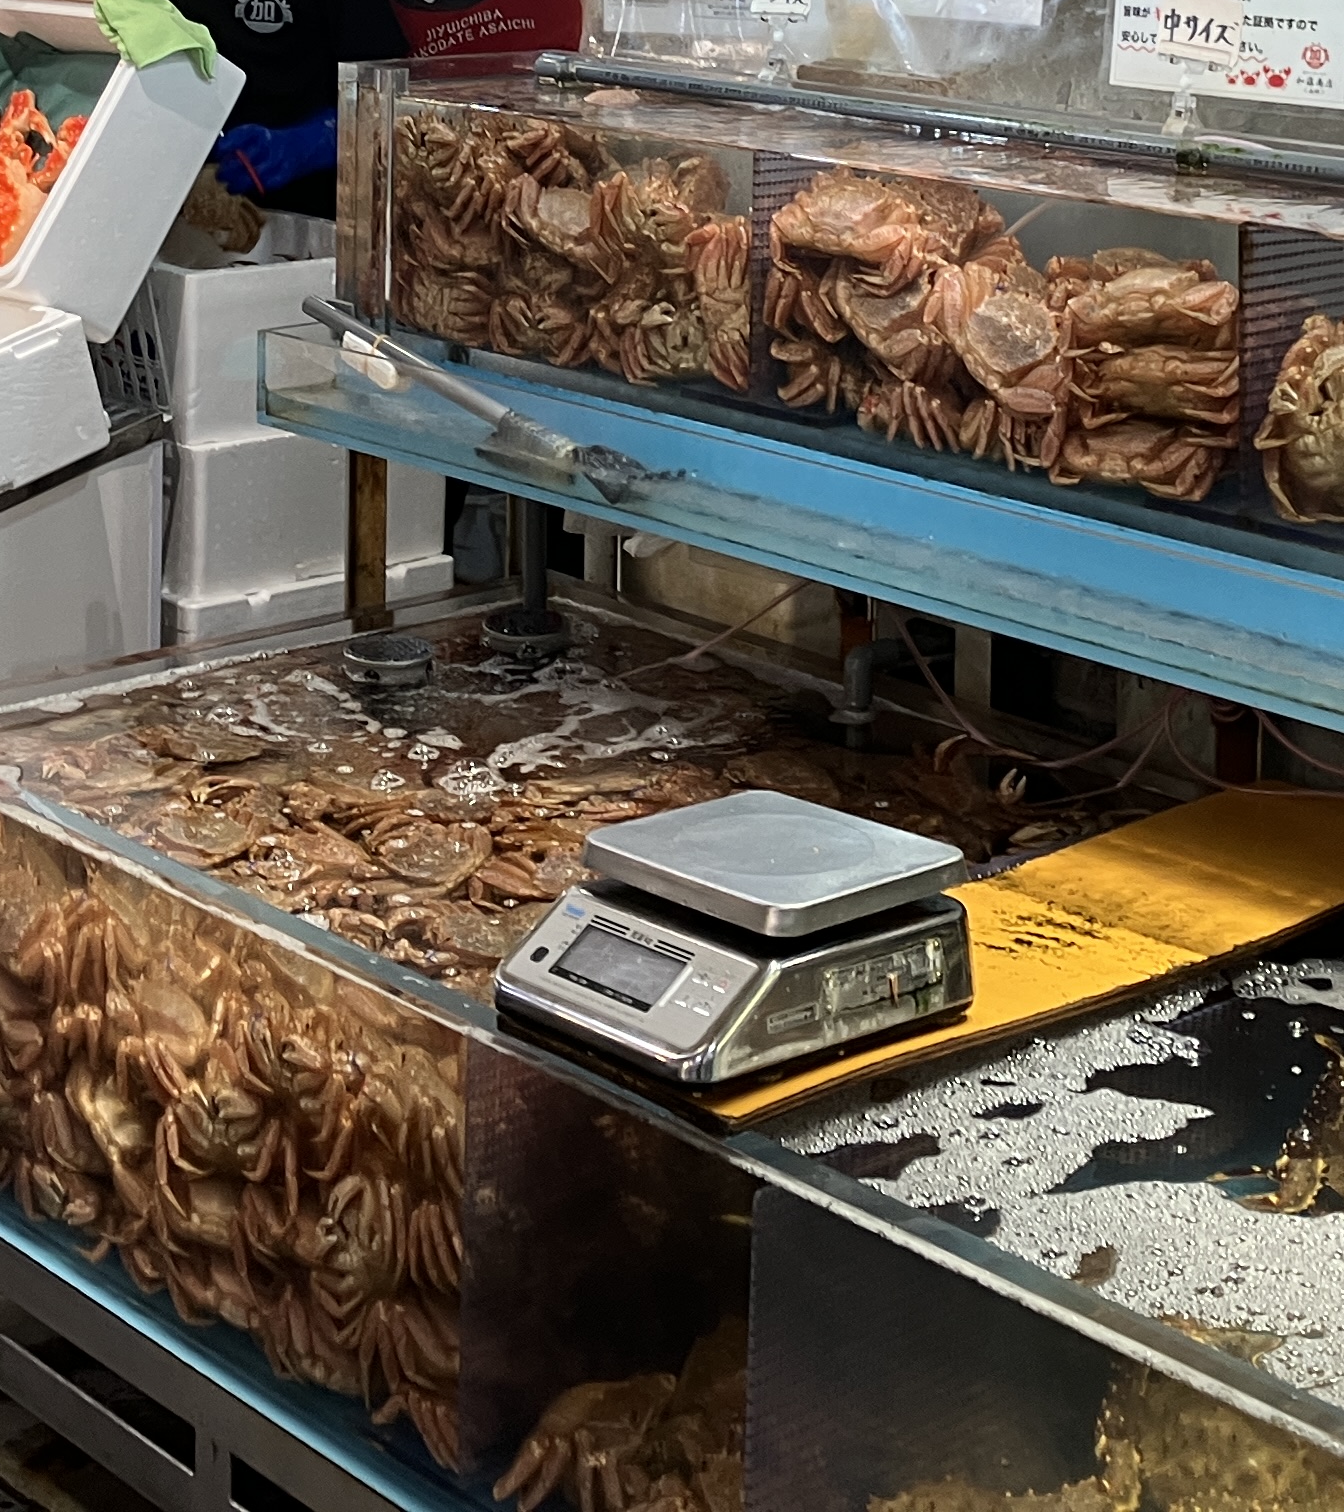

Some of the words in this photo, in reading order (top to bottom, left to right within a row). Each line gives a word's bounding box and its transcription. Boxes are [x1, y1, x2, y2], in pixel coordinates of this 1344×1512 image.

[479, 18, 536, 38] ASAICHI
[1163, 8, 1240, 47] 中サイズ
